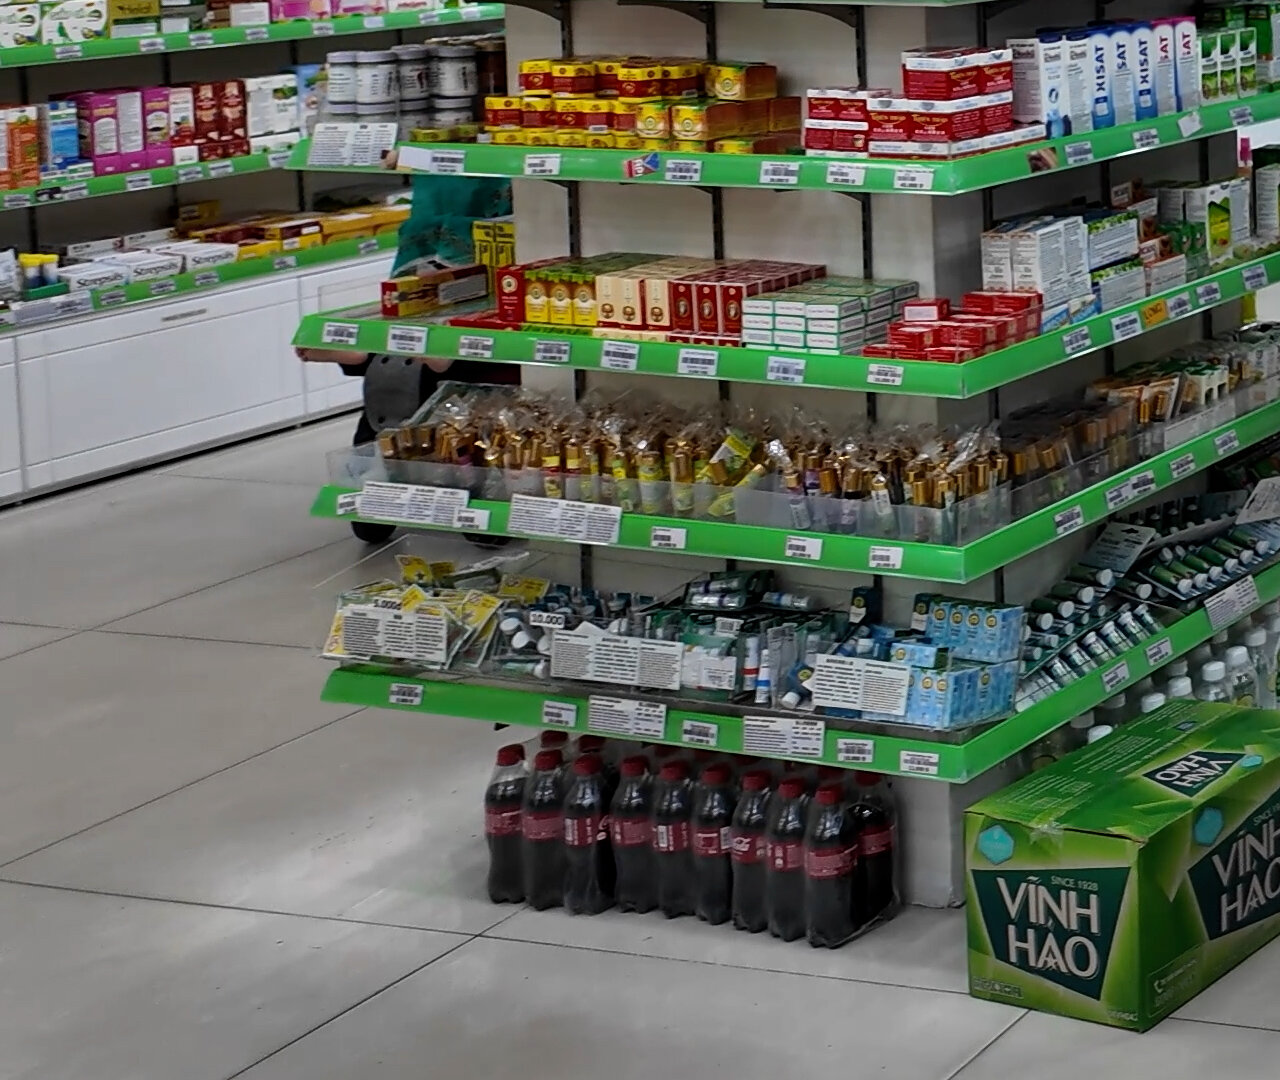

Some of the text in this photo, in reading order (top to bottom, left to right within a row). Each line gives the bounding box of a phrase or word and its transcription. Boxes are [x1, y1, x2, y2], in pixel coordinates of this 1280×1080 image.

[1117, 41, 1128, 70] SAT
[1050, 875, 1099, 891] SINCE 1928
[995, 875, 1100, 937] VĨNH
[1006, 920, 1101, 980] HẢO
